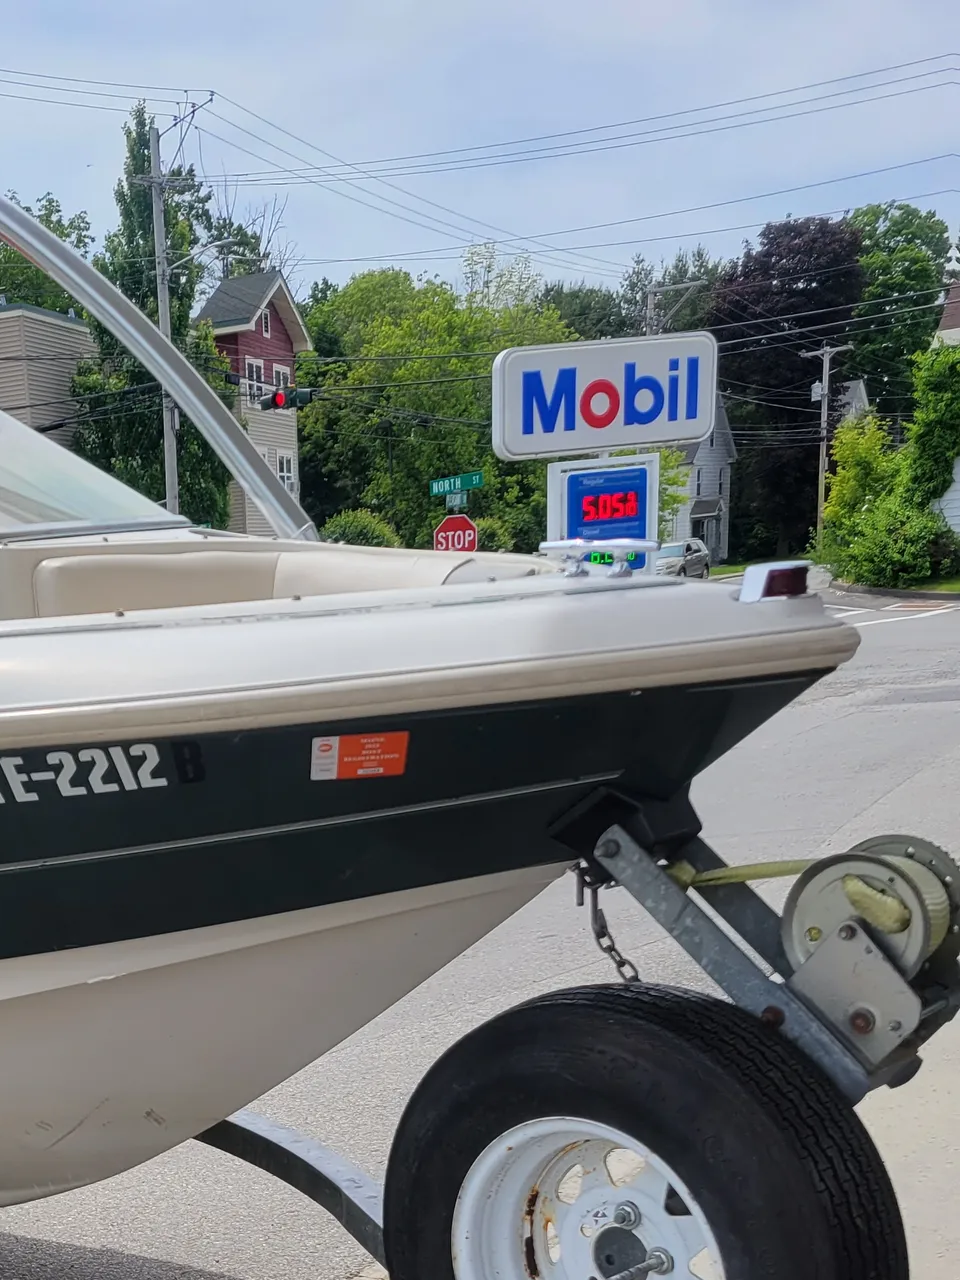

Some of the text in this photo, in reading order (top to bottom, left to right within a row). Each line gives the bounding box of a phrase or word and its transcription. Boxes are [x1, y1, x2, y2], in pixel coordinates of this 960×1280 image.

[522, 356, 700, 436] Mobil
[432, 475, 480, 493] NORTH ST
[437, 529, 475, 551] STOP
